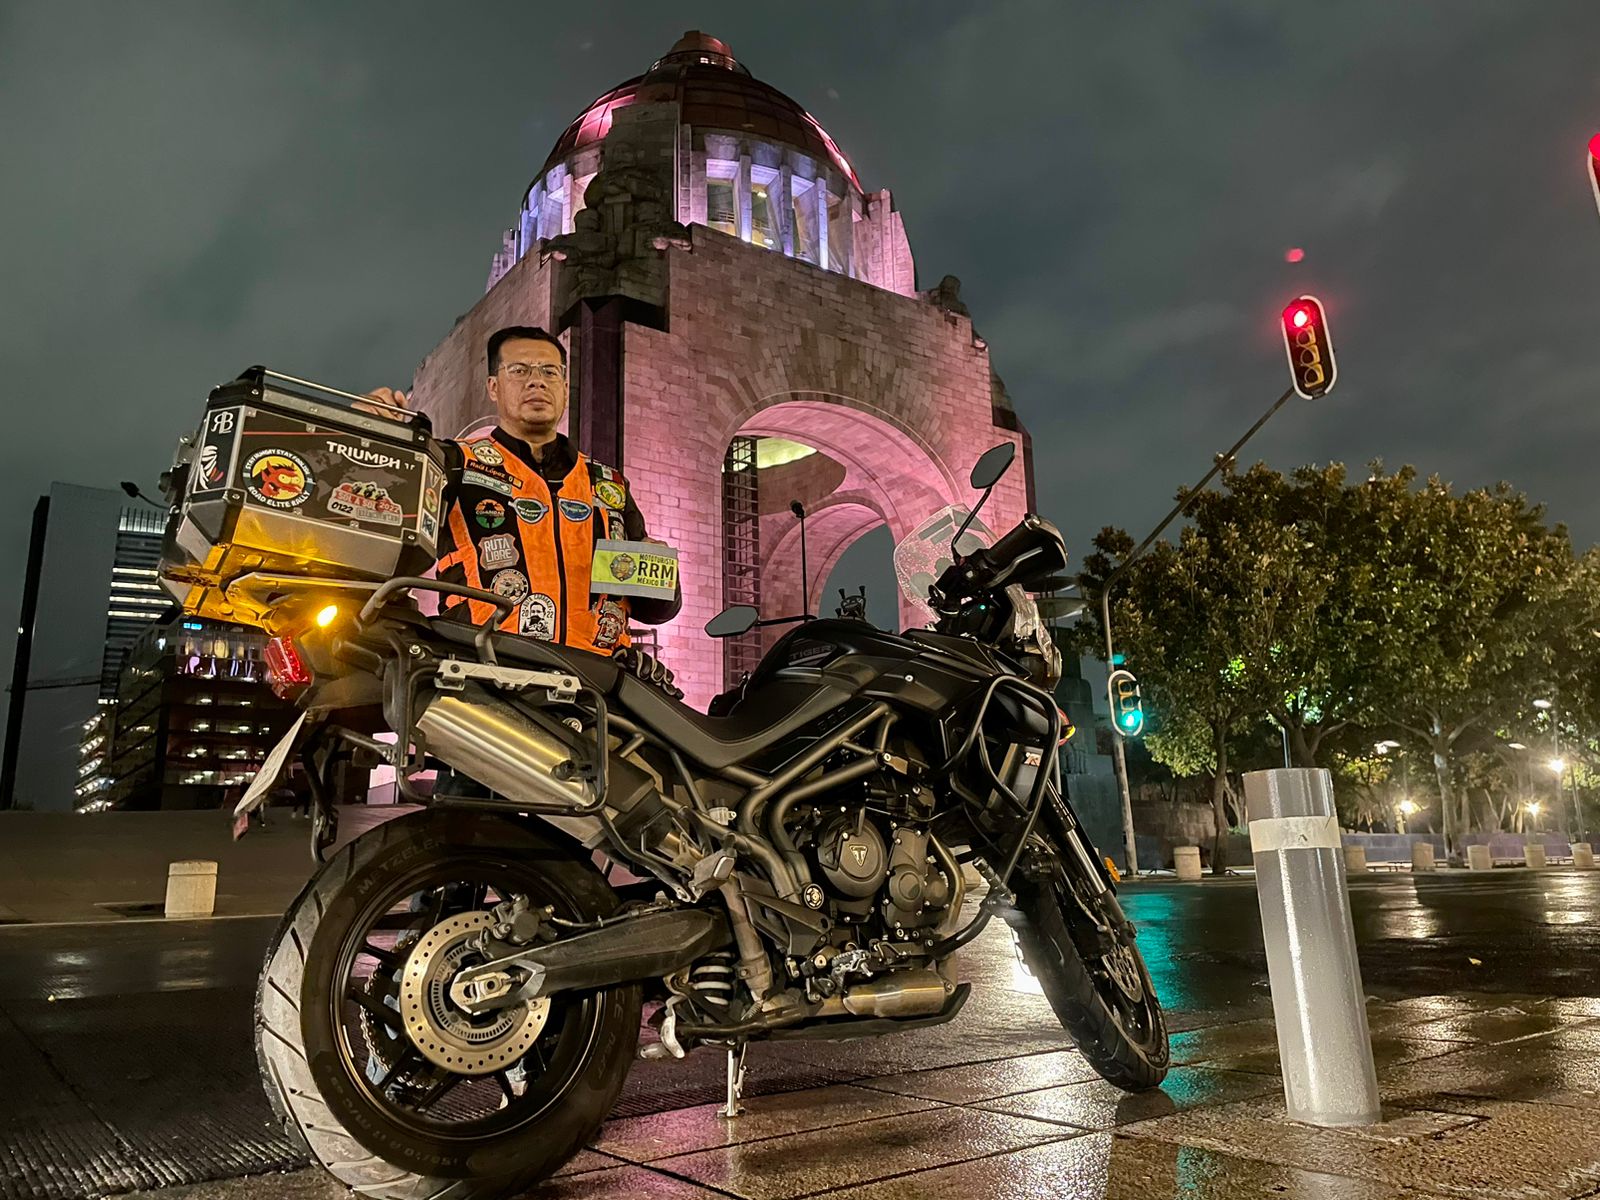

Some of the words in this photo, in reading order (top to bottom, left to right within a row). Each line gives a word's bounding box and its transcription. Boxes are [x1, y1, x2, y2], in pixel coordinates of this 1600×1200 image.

[276, 448, 294, 459] STAY
[326, 441, 400, 470] TRIUMPH
[247, 486, 267, 503] ROAD
[266, 499, 292, 508] ELITE
[291, 490, 310, 507] RALLY
[331, 501, 354, 514] 0122
[379, 501, 400, 514] 2022
[484, 538, 510, 553] RUTA
[485, 549, 512, 562] LIBRE
[639, 554, 675, 565] MOTOTURISTA
[638, 561, 674, 580] RRM
[546, 610, 554, 618] 22
[790, 645, 833, 660] TIGER
